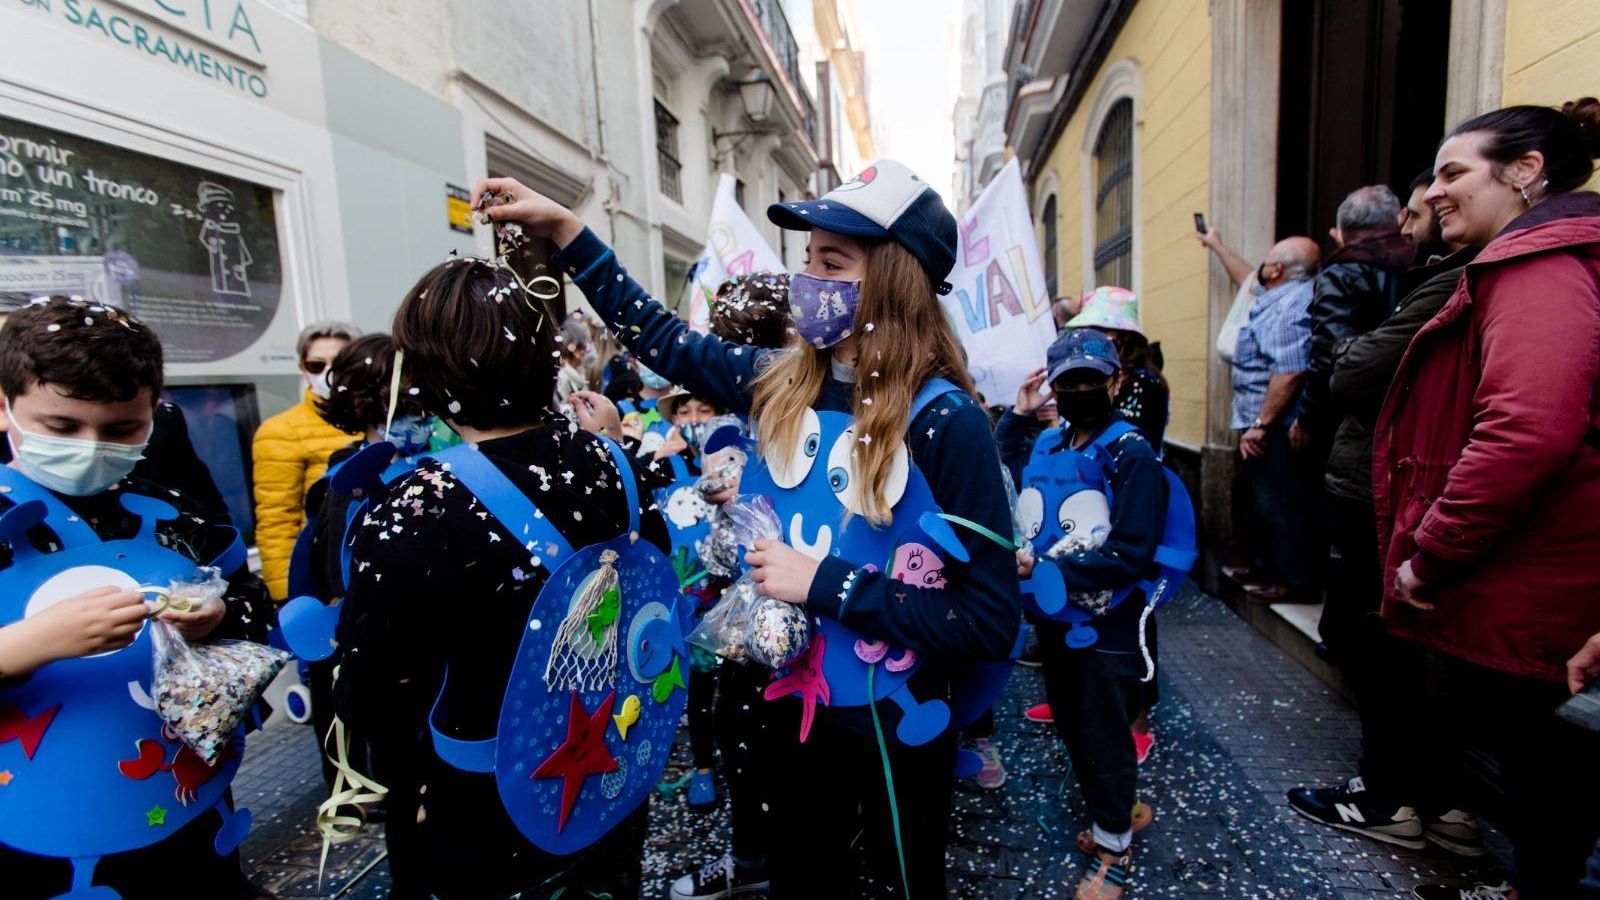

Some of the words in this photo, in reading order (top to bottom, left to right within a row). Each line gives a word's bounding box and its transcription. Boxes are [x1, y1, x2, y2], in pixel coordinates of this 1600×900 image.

[64, 0, 268, 98] SACRAMENTO
[28, 188, 54, 209] 25
[54, 198, 87, 218] mg
[37, 164, 73, 188] un
[81, 168, 159, 206] tronco
[955, 244, 1050, 334] VAL
[1334, 803, 1366, 822] N
